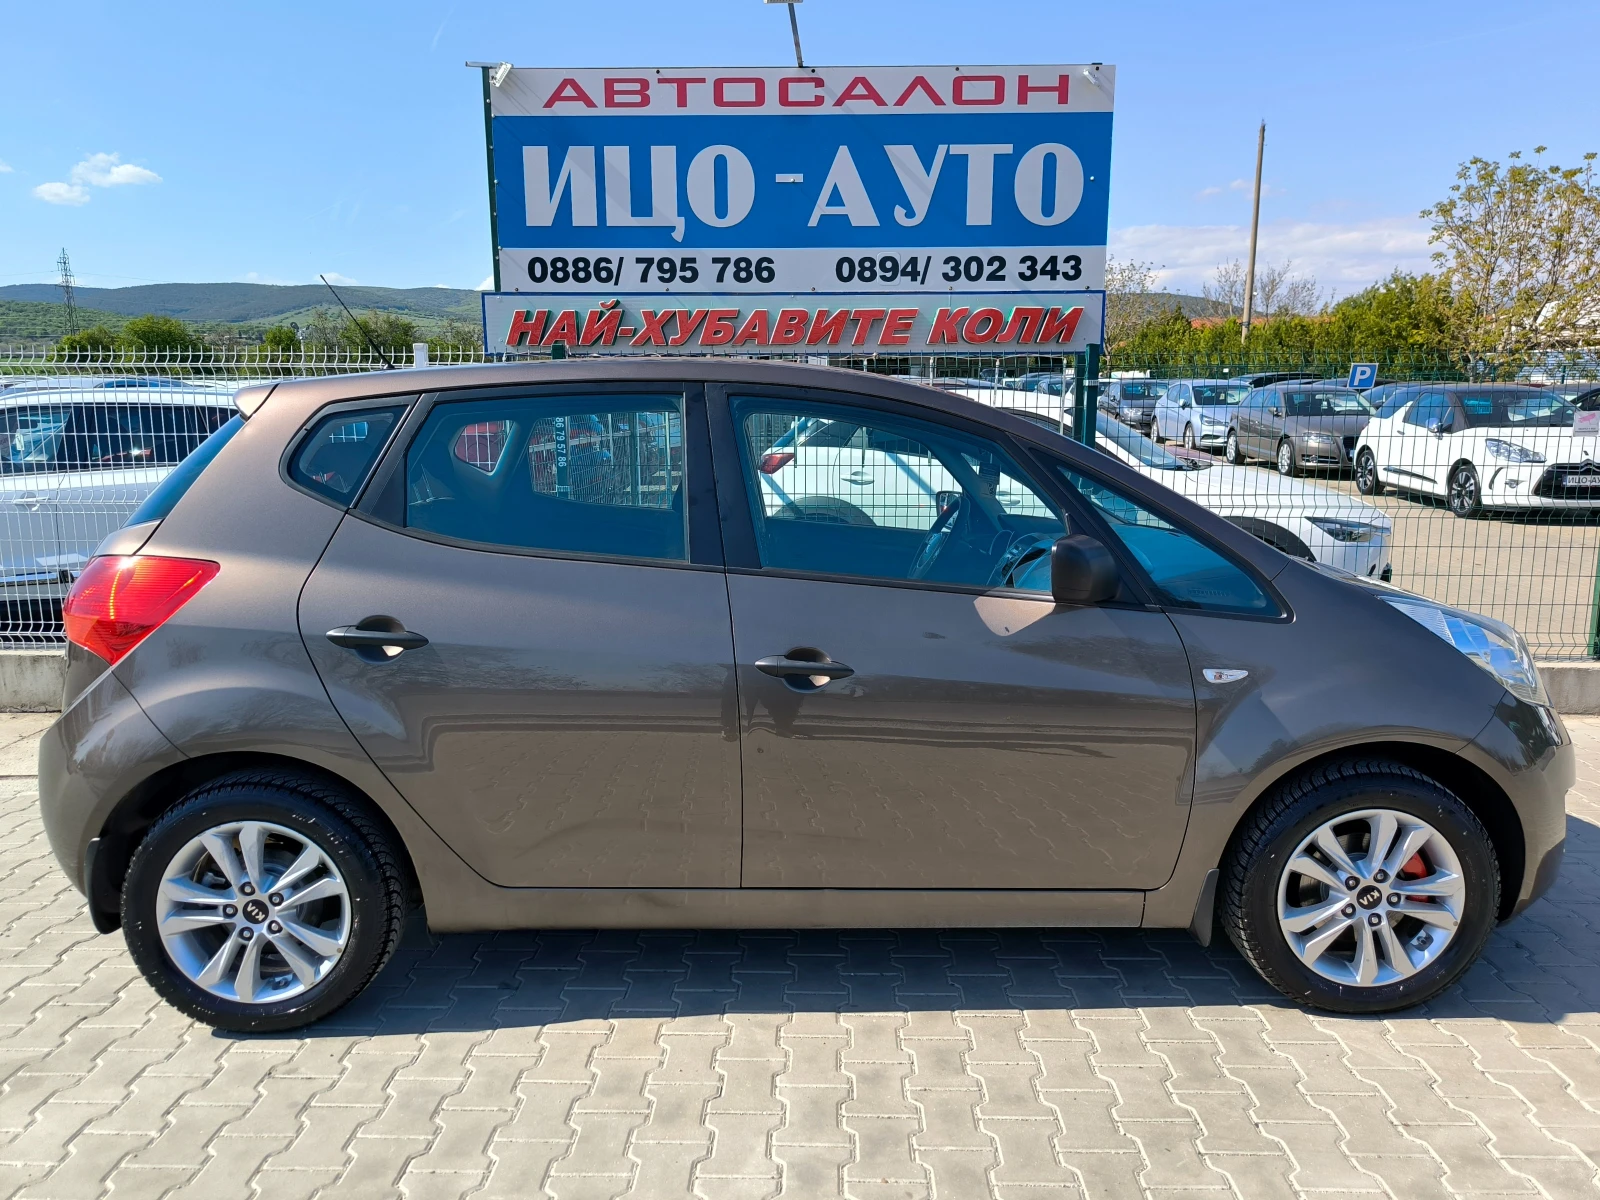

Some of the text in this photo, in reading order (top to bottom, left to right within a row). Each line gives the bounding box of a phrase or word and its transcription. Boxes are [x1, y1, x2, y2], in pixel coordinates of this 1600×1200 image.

[543, 74, 1070, 110] АВТОСАЛОН
[527, 254, 1083, 286] 0886/ 795 786 0894/ 302 343
[505, 298, 1086, 348] НАЙ-ХУБАВИТЕ КОЛИ
[1353, 366, 1371, 386] P
